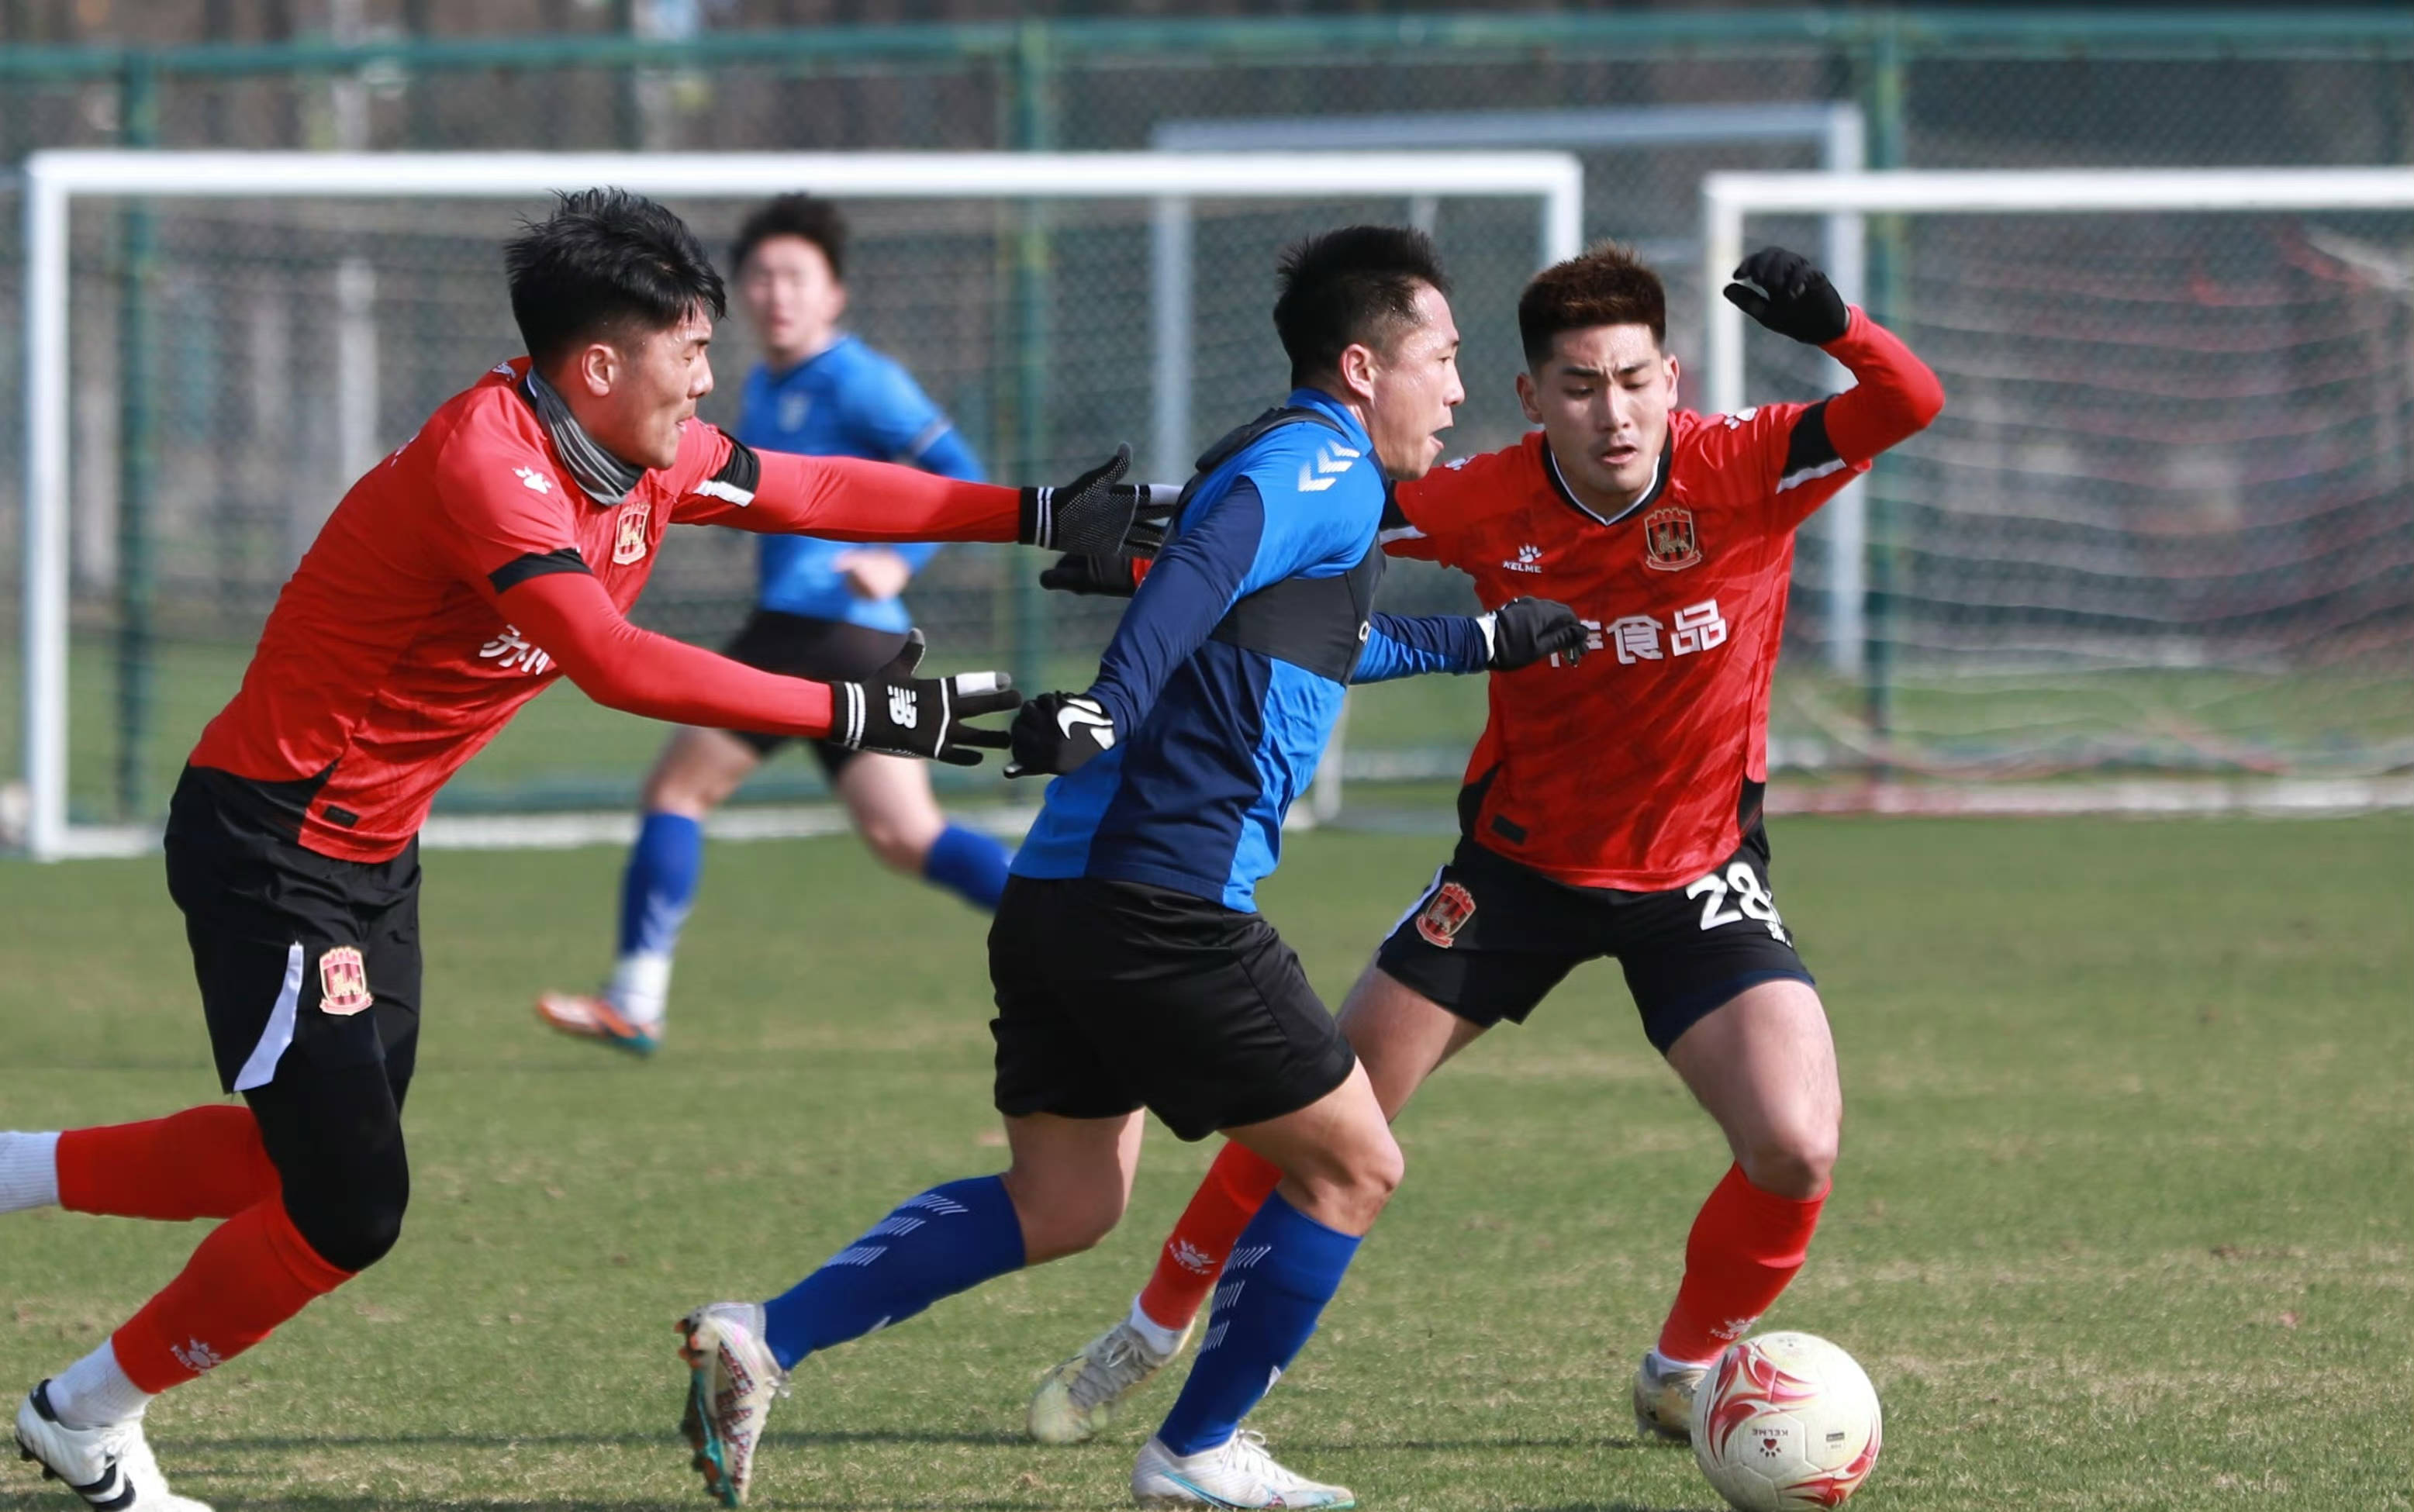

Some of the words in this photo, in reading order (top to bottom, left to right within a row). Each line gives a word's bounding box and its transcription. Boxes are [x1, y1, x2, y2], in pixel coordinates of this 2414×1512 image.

[1502, 560, 1542, 574] KELME
[1685, 861, 1778, 931] 28
[1751, 1428, 1789, 1437] KELME
